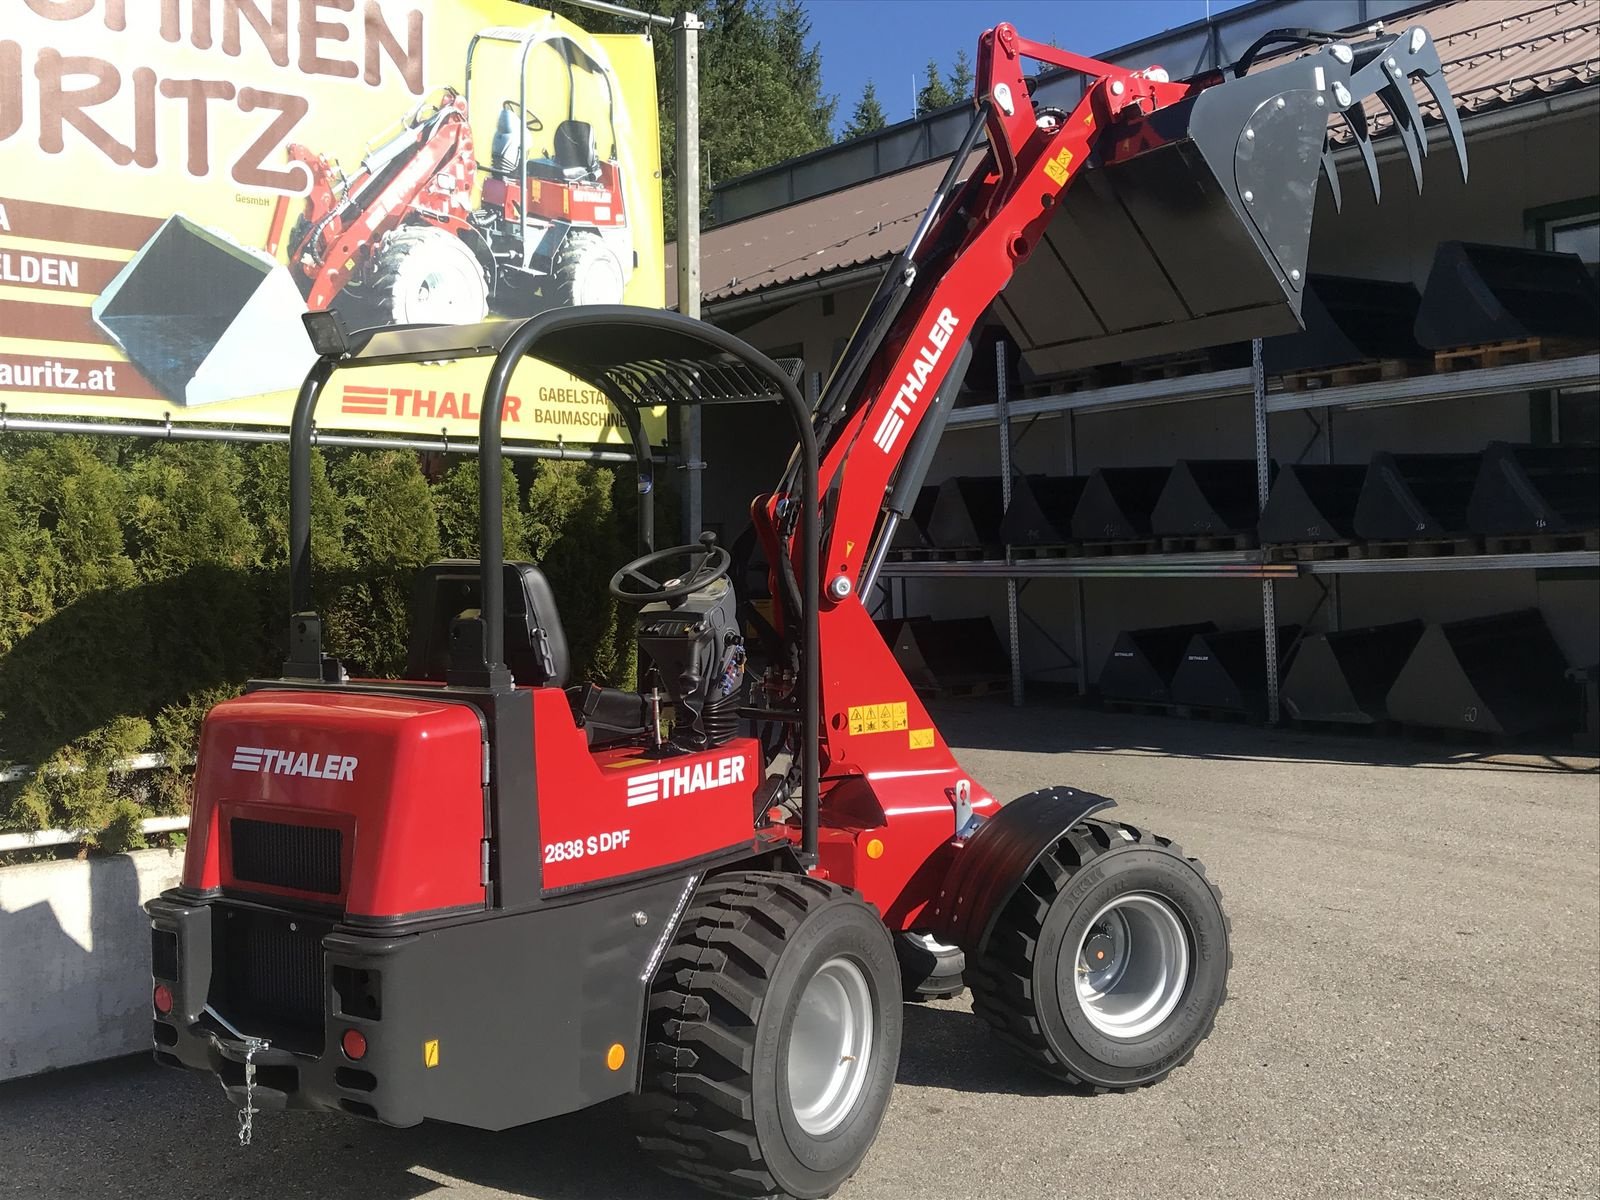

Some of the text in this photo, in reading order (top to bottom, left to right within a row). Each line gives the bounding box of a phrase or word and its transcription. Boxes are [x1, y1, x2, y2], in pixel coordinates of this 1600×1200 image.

[0, 253, 79, 288] LDEN
[0, 361, 116, 391] auritz.at
[890, 307, 960, 416] THALER
[390, 387, 522, 423] THALR
[261, 749, 358, 782] THALER
[658, 755, 746, 799] THALER
[544, 839, 584, 864] 2838
[599, 829, 631, 852] DPF
